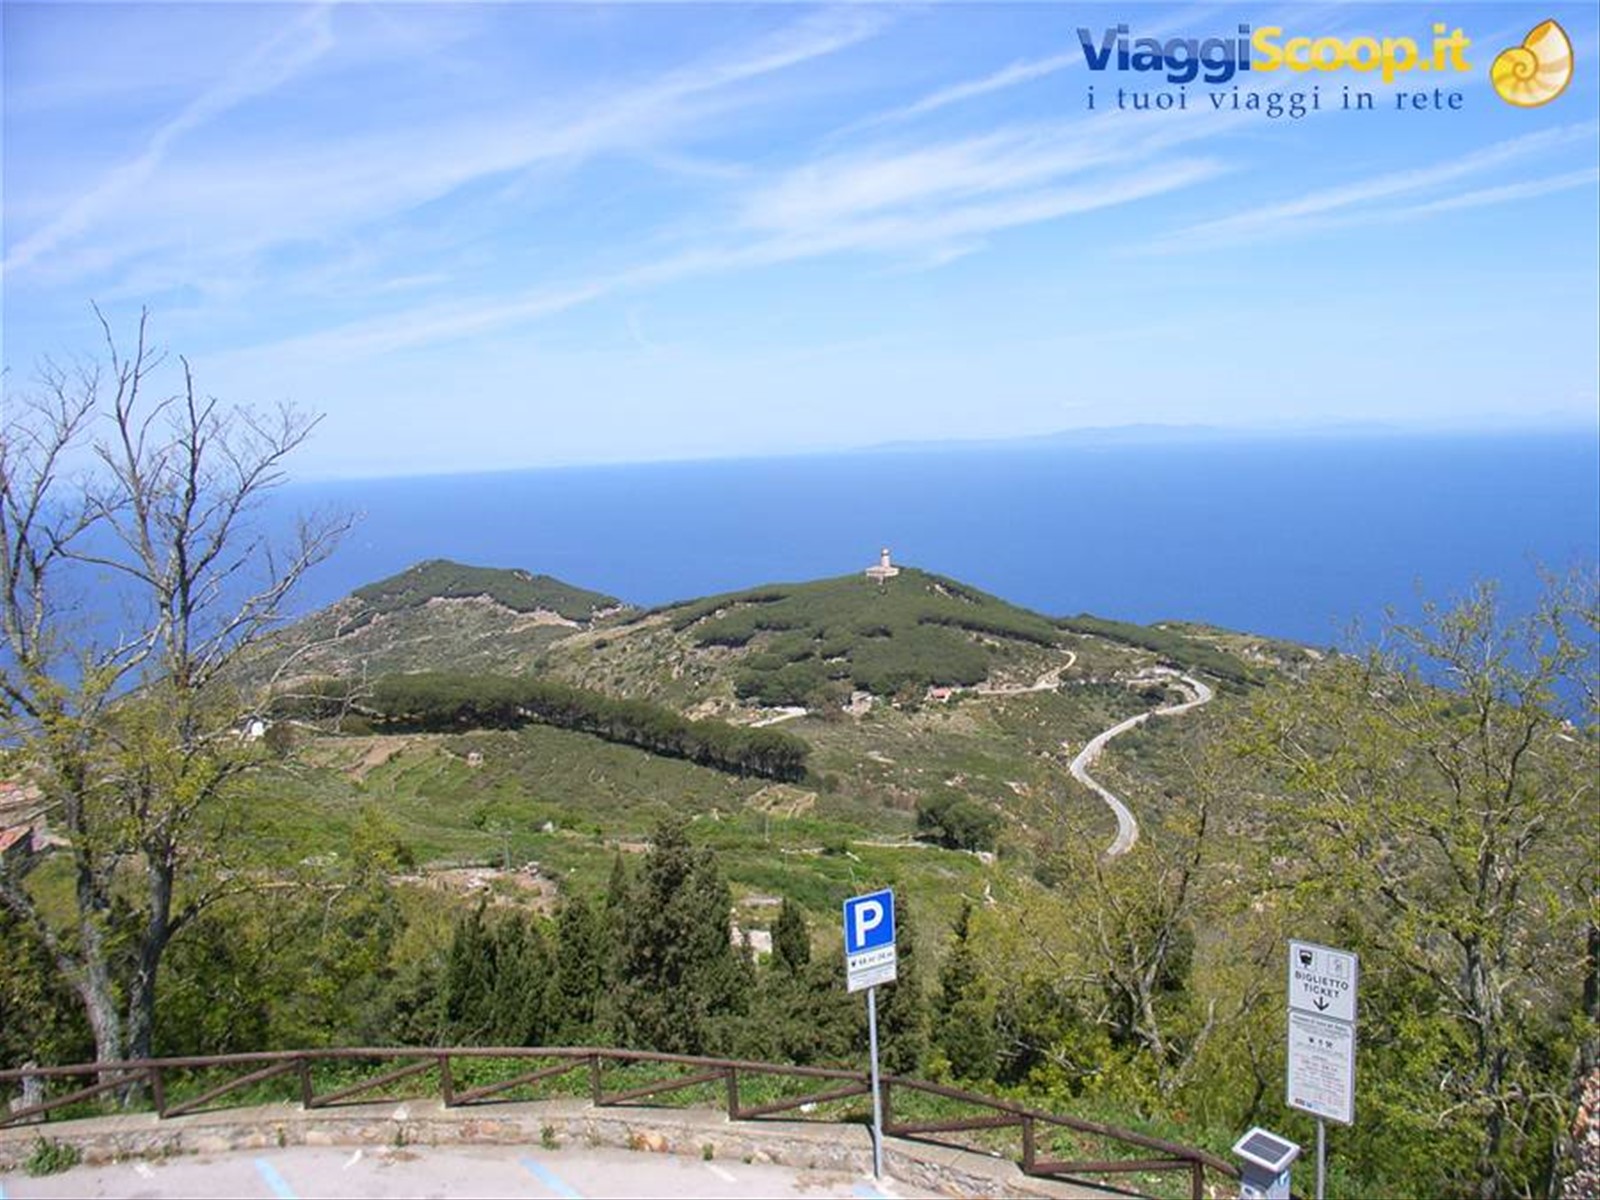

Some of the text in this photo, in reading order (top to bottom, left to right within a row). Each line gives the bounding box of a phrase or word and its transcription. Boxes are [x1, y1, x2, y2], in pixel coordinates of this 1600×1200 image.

[855, 900, 884, 947] P
[1295, 970, 1349, 991] BIGLIETTO
[1304, 983, 1340, 997] TICKET
